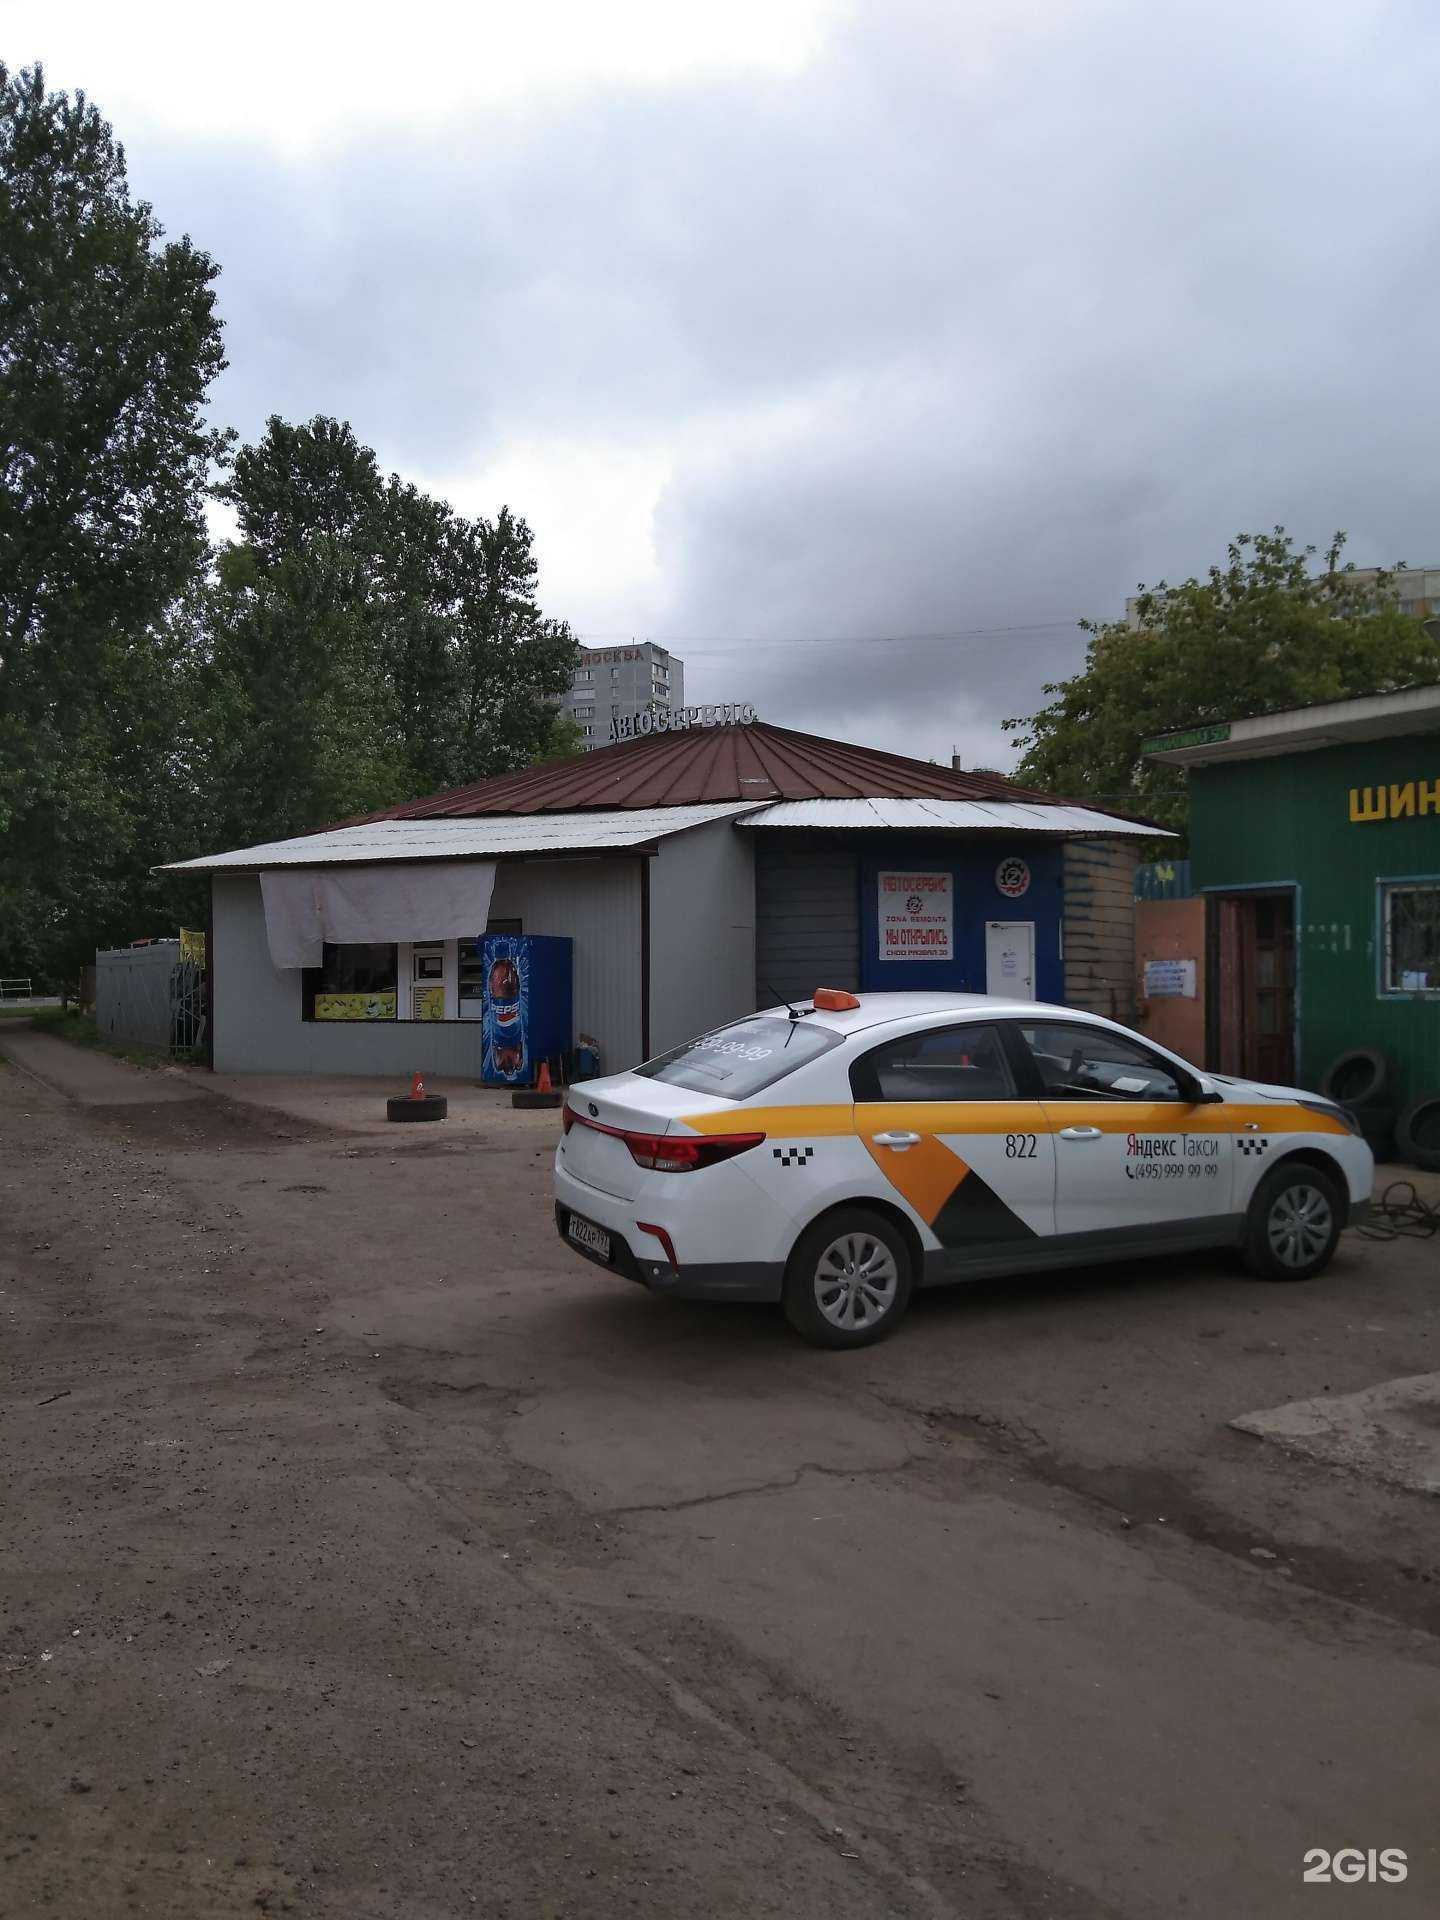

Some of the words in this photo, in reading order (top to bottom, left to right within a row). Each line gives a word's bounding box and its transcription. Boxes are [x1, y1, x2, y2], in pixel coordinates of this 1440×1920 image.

[608, 703, 756, 741] АВТОСЕРВИС
[1005, 1134, 1038, 1158] 822
[1127, 1133, 1177, 1158] Яндекс
[1181, 1133, 1219, 1157] Такси
[1135, 1163, 1163, 1180] (495)
[1165, 1163, 1185, 1178] 999
[1188, 1163, 1202, 1178] 99
[1205, 1163, 1219, 1178] 99
